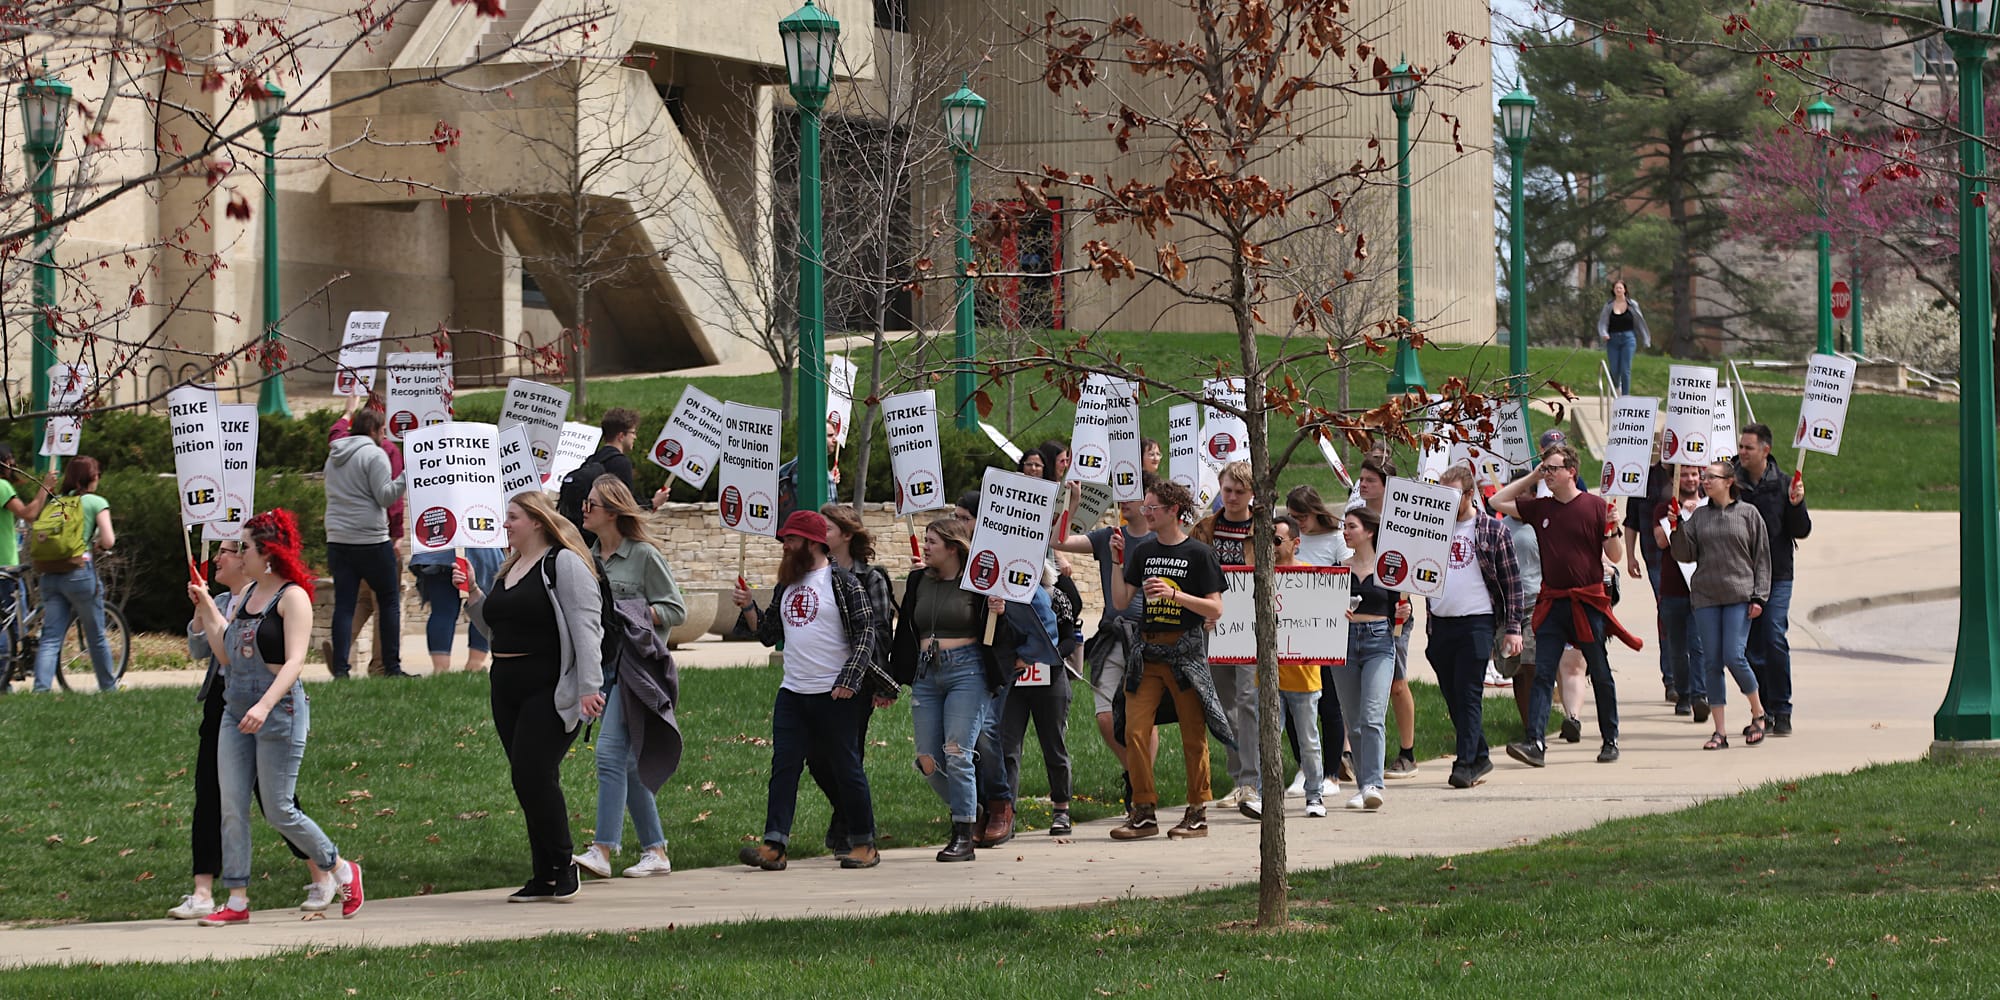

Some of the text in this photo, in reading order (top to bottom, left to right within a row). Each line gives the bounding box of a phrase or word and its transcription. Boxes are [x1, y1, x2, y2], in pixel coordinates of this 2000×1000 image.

[1831, 294, 1849, 308] STOP
[396, 375, 442, 384] For Union
[1813, 366, 1846, 379] STRIKE
[1676, 378, 1711, 389] STRIKE
[1813, 379, 1840, 391] Union
[391, 387, 441, 398] Recognitio
[513, 390, 563, 409] ON STRIKE
[1678, 392, 1707, 402] Union
[513, 401, 557, 418] For Union
[686, 397, 700, 410] ON
[887, 405, 927, 422] STRIKE
[1108, 414, 1128, 425] nion
[1618, 408, 1650, 418] STRIKE
[505, 411, 559, 431] Recognition
[682, 409, 722, 437] For Union
[726, 418, 773, 436] ON STRIKE
[1618, 422, 1645, 432] Union
[172, 422, 204, 438] nion
[560, 430, 593, 441] STRIKE
[673, 416, 721, 450] Recognition
[891, 424, 924, 437] Union
[1813, 427, 1833, 440] UE
[175, 440, 214, 455] nition
[413, 437, 490, 453] ON STRIKE
[560, 440, 586, 450] Union
[728, 436, 769, 453] For Union
[893, 439, 933, 456] gnition
[1687, 441, 1704, 453] UE
[532, 446, 549, 460] UE
[556, 450, 587, 460] gnition
[420, 455, 486, 470] For Union
[686, 460, 704, 476] UE
[723, 452, 774, 471] Recognition
[1078, 454, 1103, 468] UE
[413, 472, 495, 488] Recognition
[1117, 472, 1134, 486] UE
[1622, 472, 1640, 483] UE
[910, 481, 933, 496] UE
[989, 483, 1004, 496] ON
[1006, 487, 1048, 507] STRIKE
[187, 488, 215, 506] UE
[1392, 491, 1451, 512] ON STRIKE
[749, 503, 769, 519] UE
[990, 501, 1041, 522] For Union
[1395, 507, 1445, 525] For Union
[468, 517, 495, 531] UE
[982, 516, 1045, 541] Recognition
[1386, 520, 1448, 542] Recognition
[1145, 557, 1188, 568] FORWARD
[1008, 569, 1032, 587] UE
[1143, 567, 1188, 578] TOGETHER!
[1416, 567, 1438, 583] UE
[1274, 572, 1339, 590] VESTMENT
[1229, 622, 1244, 634] AN
[1326, 617, 1337, 628] IN
